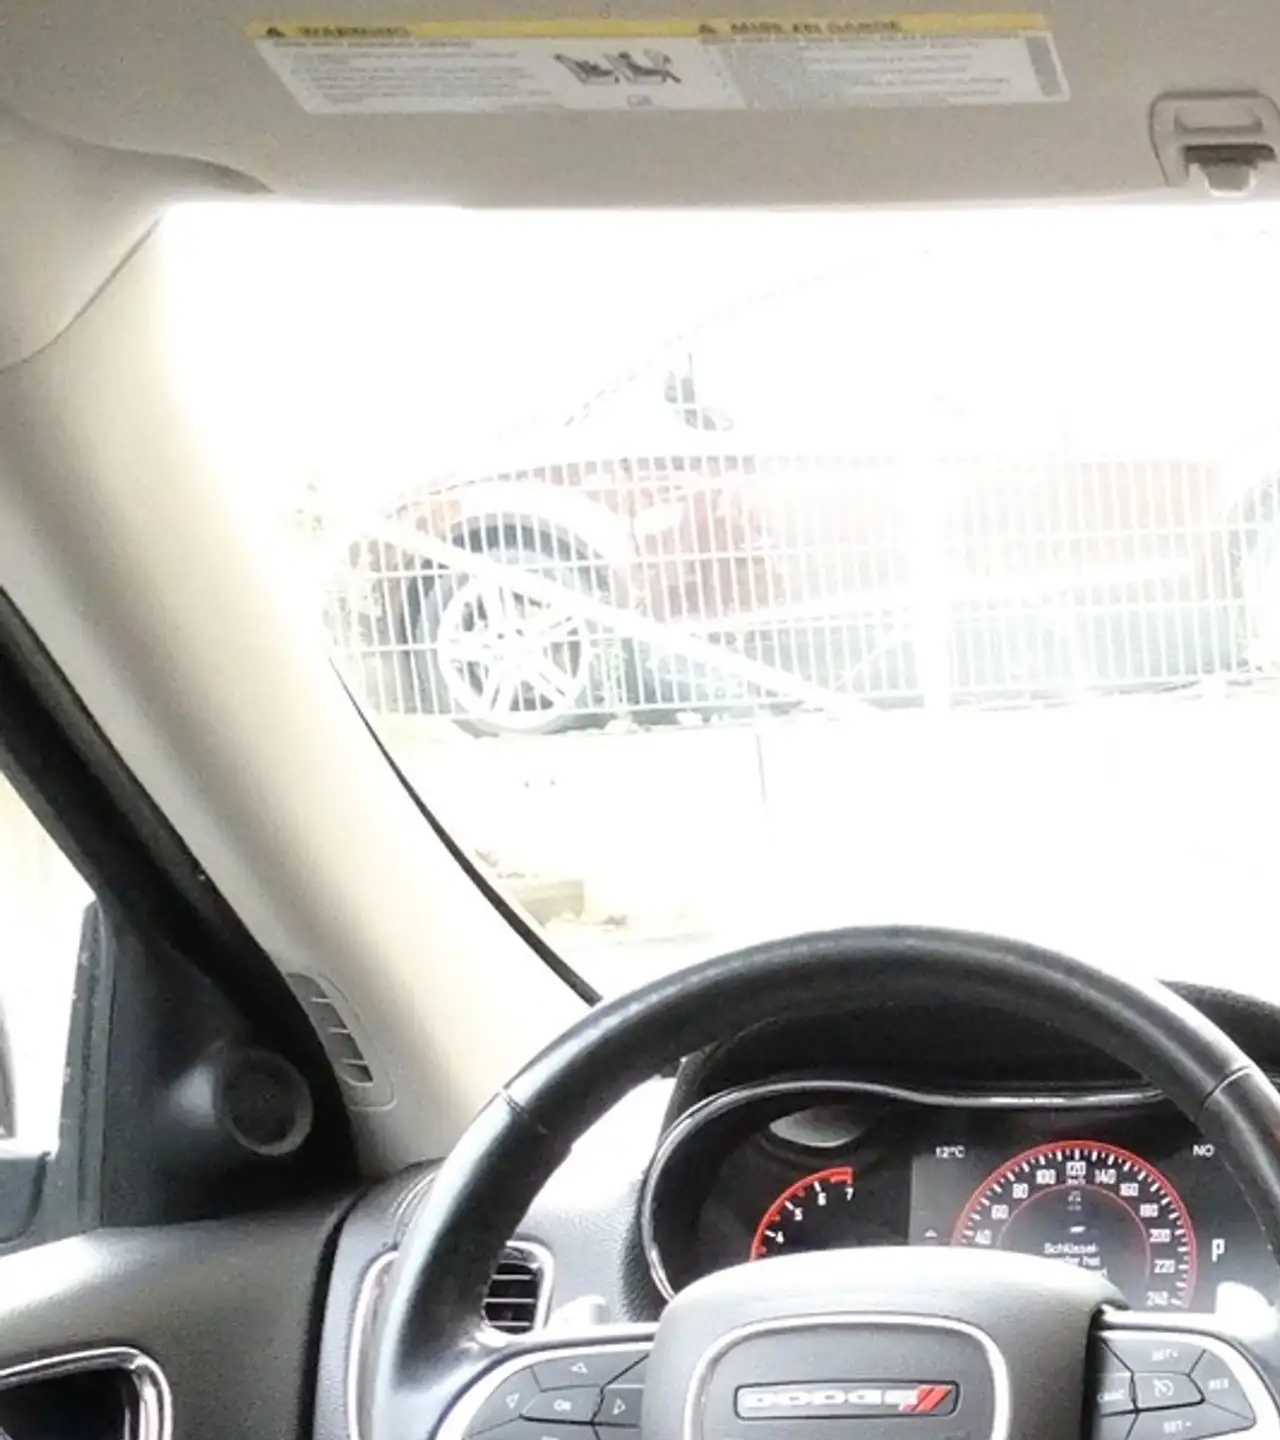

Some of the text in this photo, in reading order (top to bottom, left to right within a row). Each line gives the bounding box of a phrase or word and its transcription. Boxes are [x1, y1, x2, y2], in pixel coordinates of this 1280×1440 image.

[935, 1146, 966, 1158] 12°C
[1193, 1145, 1215, 1156] NO
[1065, 1161, 1087, 1176] 120
[1035, 1169, 1057, 1185] 100
[1094, 1169, 1117, 1185] 140
[844, 1187, 854, 1201] 7
[1012, 1183, 1029, 1199] 80
[1119, 1182, 1139, 1197] 160
[817, 1192, 828, 1206] 6
[793, 1206, 804, 1221] 5
[991, 1204, 1010, 1220] 60
[775, 1231, 785, 1244] 4
[974, 1229, 992, 1245] 40
[1149, 1228, 1171, 1243] 200
[1211, 1238, 1226, 1262] P
[1153, 1259, 1176, 1274] 220
[1146, 1291, 1169, 1307] 240
[737, 1388, 920, 1408] DODGE
